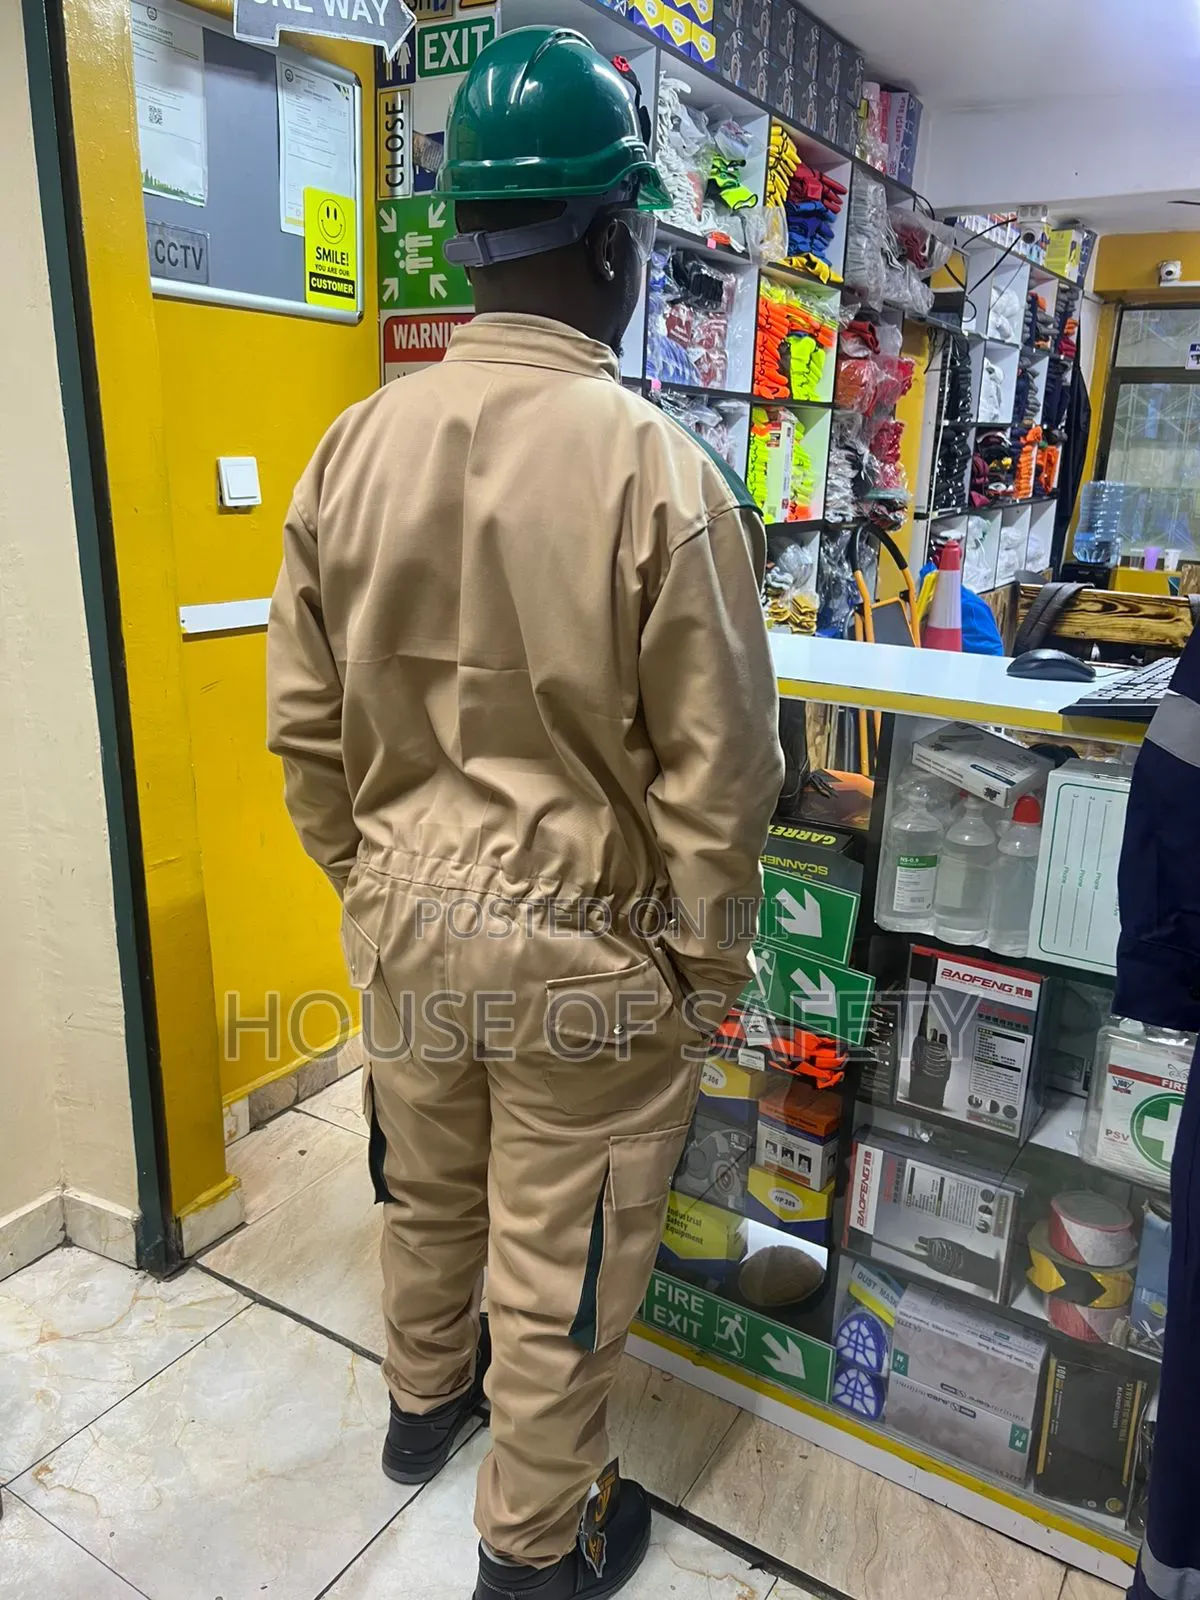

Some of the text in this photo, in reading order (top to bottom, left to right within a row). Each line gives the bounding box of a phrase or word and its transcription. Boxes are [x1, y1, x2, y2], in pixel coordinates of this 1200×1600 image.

[323, 0, 389, 27] WAY
[424, 24, 490, 70] EXIT
[385, 100, 404, 188] CLOSE
[154, 239, 204, 271] CCTV
[315, 246, 349, 266] SMILE!
[315, 264, 350, 278] YOU ARE OUR
[310, 277, 354, 295] CUSTOMER
[393, 322, 460, 350] WARNI
[941, 968, 1014, 994] BAOFENG
[1161, 1079, 1187, 1092] FIRS
[1105, 1129, 1130, 1142] PSV
[857, 1165, 870, 1227] BAOFENG
[666, 1214, 688, 1231] Safety
[667, 1205, 702, 1227] Industrial
[665, 1223, 704, 1245] Equipment
[857, 1271, 877, 1290] DUST
[654, 1279, 705, 1317] FIRE
[653, 1303, 703, 1339] EXIT
